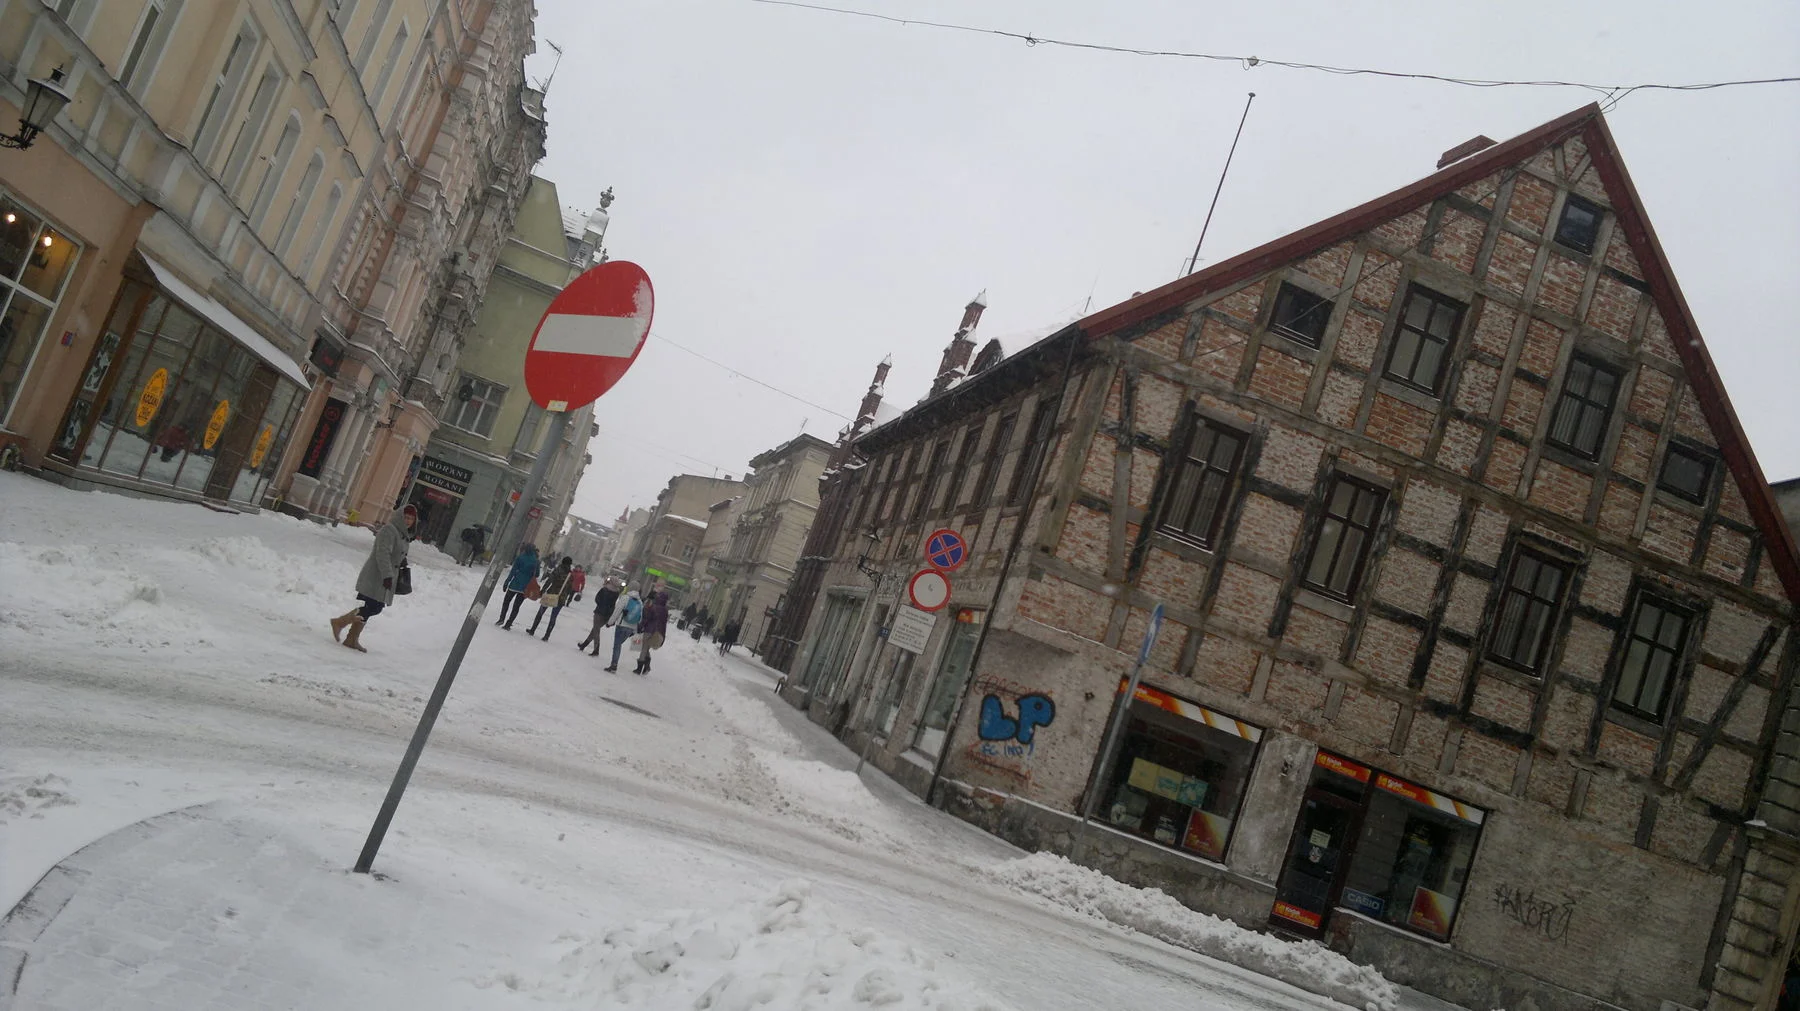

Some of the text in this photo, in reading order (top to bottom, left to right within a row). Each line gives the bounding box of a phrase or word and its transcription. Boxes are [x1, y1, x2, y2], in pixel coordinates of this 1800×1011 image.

[425, 460, 469, 480] MORANI
[424, 474, 463, 494] MORANI
[1346, 892, 1380, 910] CASIO
